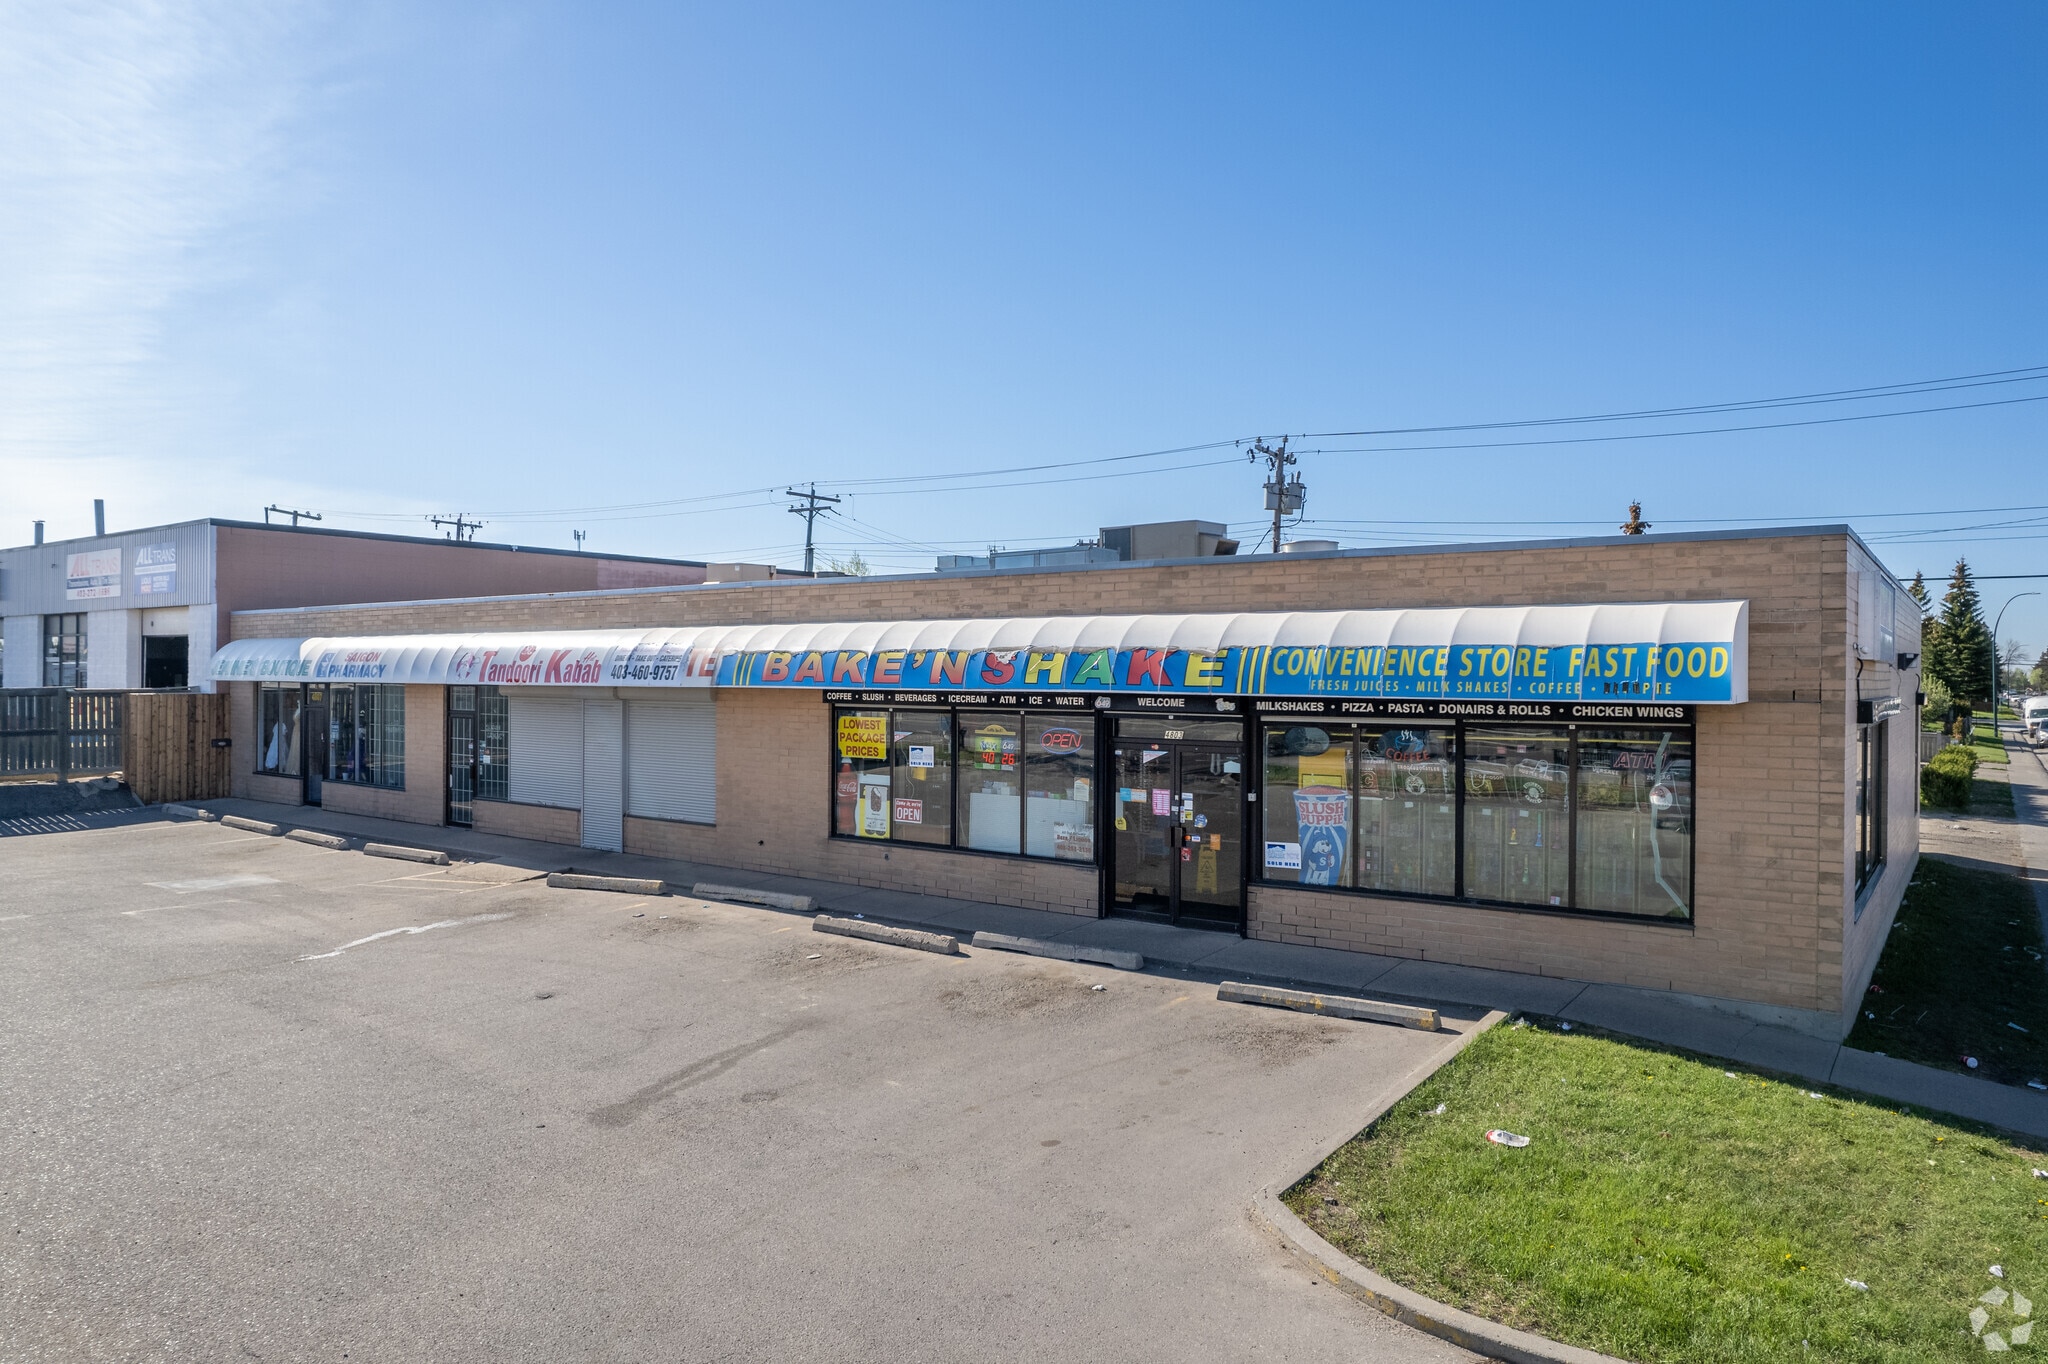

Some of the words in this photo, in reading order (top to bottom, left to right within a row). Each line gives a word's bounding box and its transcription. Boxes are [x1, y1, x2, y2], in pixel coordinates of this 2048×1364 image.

[345, 652, 382, 662] SAIGON
[1273, 648, 1448, 676] CONVENIENCE
[1459, 648, 1548, 677] STORE
[1568, 647, 1637, 678] FAST
[1646, 646, 1728, 678] FOOD
[260, 660, 312, 676] BOUTIQUE
[328, 664, 386, 678] PHARMACY
[479, 651, 543, 683] Tandoori
[544, 650, 602, 683] Kabab
[611, 665, 678, 681] 403-460-9757
[981, 648, 1228, 687] SHAKE
[1311, 680, 1348, 691] FRESH
[1355, 680, 1399, 692] JUICES
[1416, 681, 1450, 693] MILK
[1457, 681, 1508, 694] SHAKES
[1529, 682, 1581, 695] COFFEE
[827, 692, 852, 700] COFFEE
[862, 693, 884, 701] SLUSH
[895, 693, 937, 702] BEVERAGES
[948, 694, 987, 703] ICECREAM
[1000, 696, 1016, 704] ATM
[1029, 696, 1043, 704] ICE
[1055, 697, 1084, 705] WATER
[1137, 697, 1185, 707] WELCOME
[1256, 701, 1324, 712] MILKSHAKES
[1342, 703, 1374, 713] PIZZA
[1388, 703, 1424, 713] PASTA
[1439, 704, 1494, 714] DONAIRS
[1497, 705, 1506, 715] &
[1509, 705, 1551, 715] ROLLS
[1572, 705, 1635, 717] CHICKEN
[1637, 706, 1684, 717] WINGS
[843, 719, 881, 730] LOWEST
[839, 732, 885, 744] PACKAGE
[1041, 733, 1083, 748] OPEN
[1165, 730, 1183, 739] 4803
[845, 746, 879, 757] PRICES
[982, 752, 995, 764] 40
[1002, 753, 1015, 765] 26
[1385, 748, 1430, 762] COFFEE
[1613, 751, 1667, 769] ATM
[897, 807, 920, 821] OPEN
[1299, 801, 1344, 815] SLUSH
